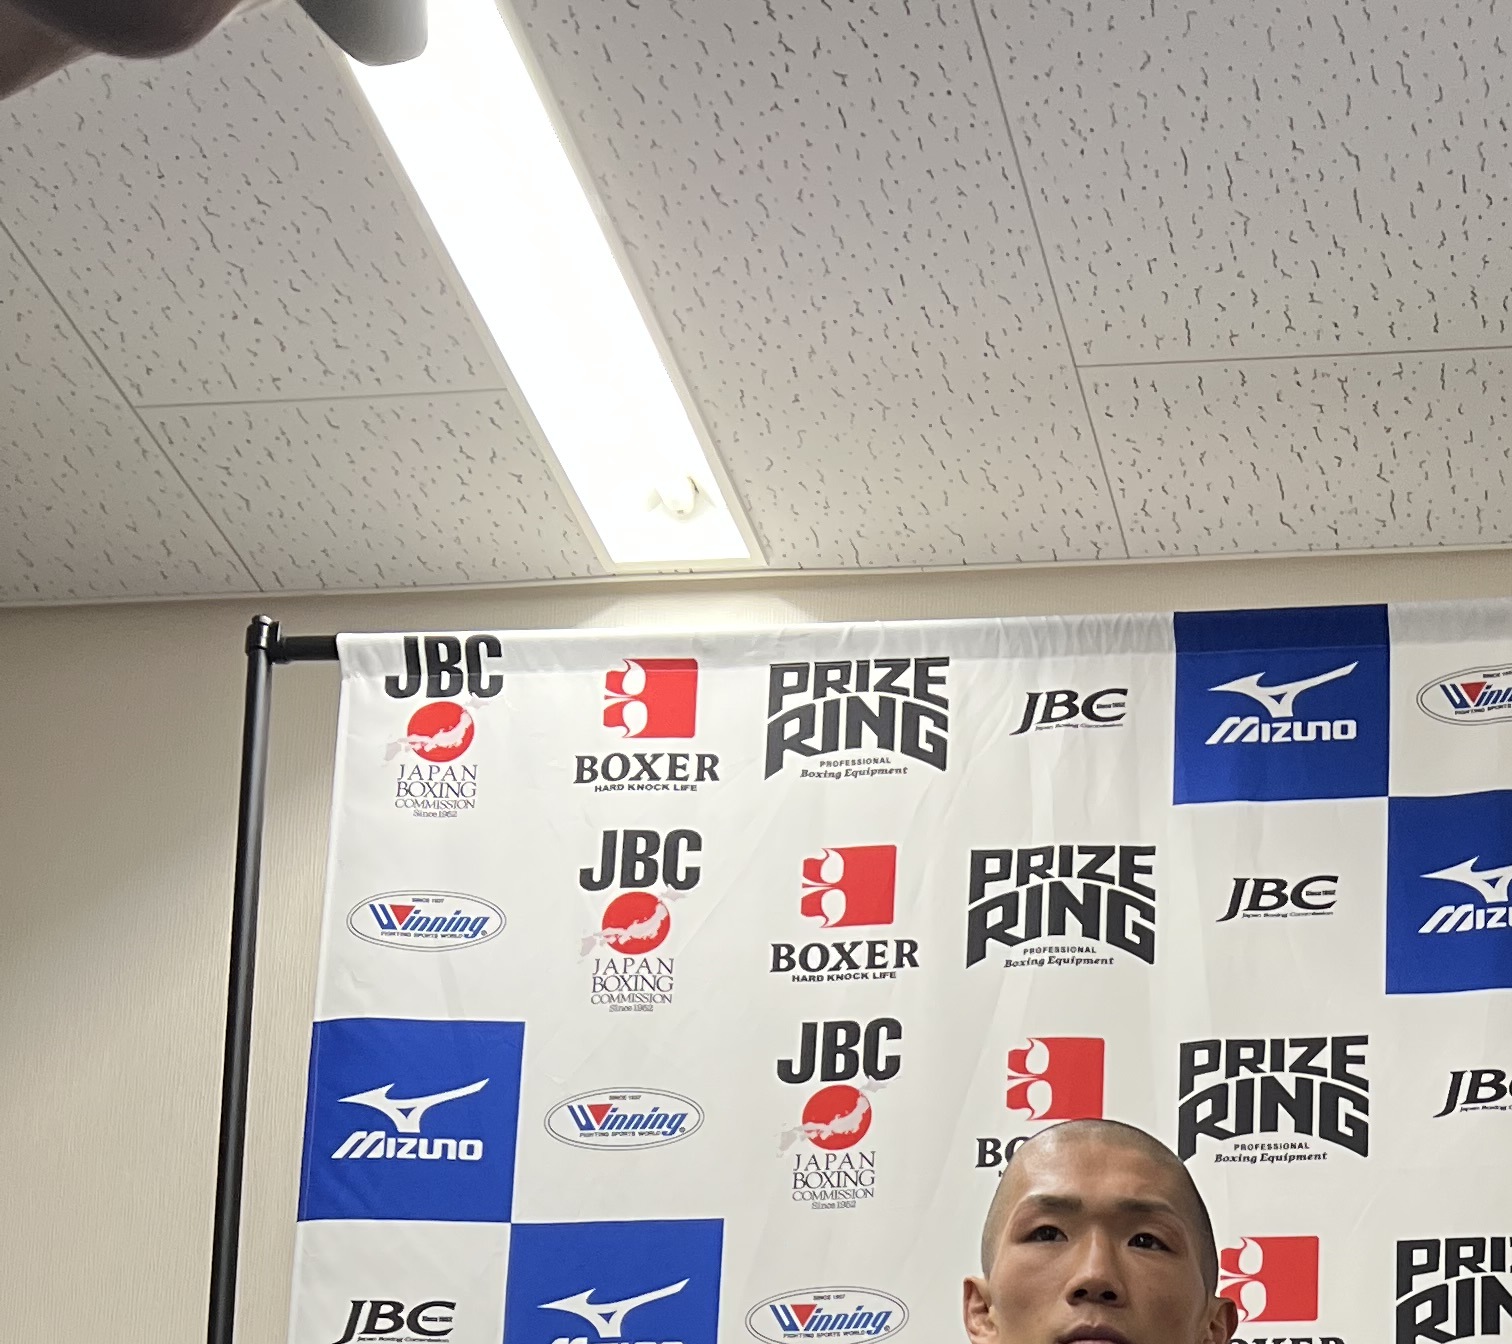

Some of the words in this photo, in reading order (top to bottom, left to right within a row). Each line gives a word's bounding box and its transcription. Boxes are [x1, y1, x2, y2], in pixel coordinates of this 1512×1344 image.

[385, 635, 503, 698] JBC
[768, 656, 949, 718] PRIZE
[1011, 688, 1128, 735] JBC
[765, 695, 948, 780] RING
[574, 753, 719, 783] BOXER
[580, 829, 701, 891] JBC
[969, 845, 1156, 904] PRIZE
[367, 905, 488, 939] Winning
[966, 881, 1155, 968] RING
[593, 958, 674, 975] JAPAN
[770, 940, 919, 972] BOXER
[591, 993, 672, 1004] COMMISSION
[593, 975, 673, 993] BOXING
[777, 1018, 902, 1084] JBC
[1179, 1035, 1369, 1100] PRIZE
[1179, 1075, 1370, 1163] RING
[332, 1131, 483, 1160] MIZUNO
[331, 1300, 456, 1344] JBC
[768, 1305, 891, 1335] Winning
